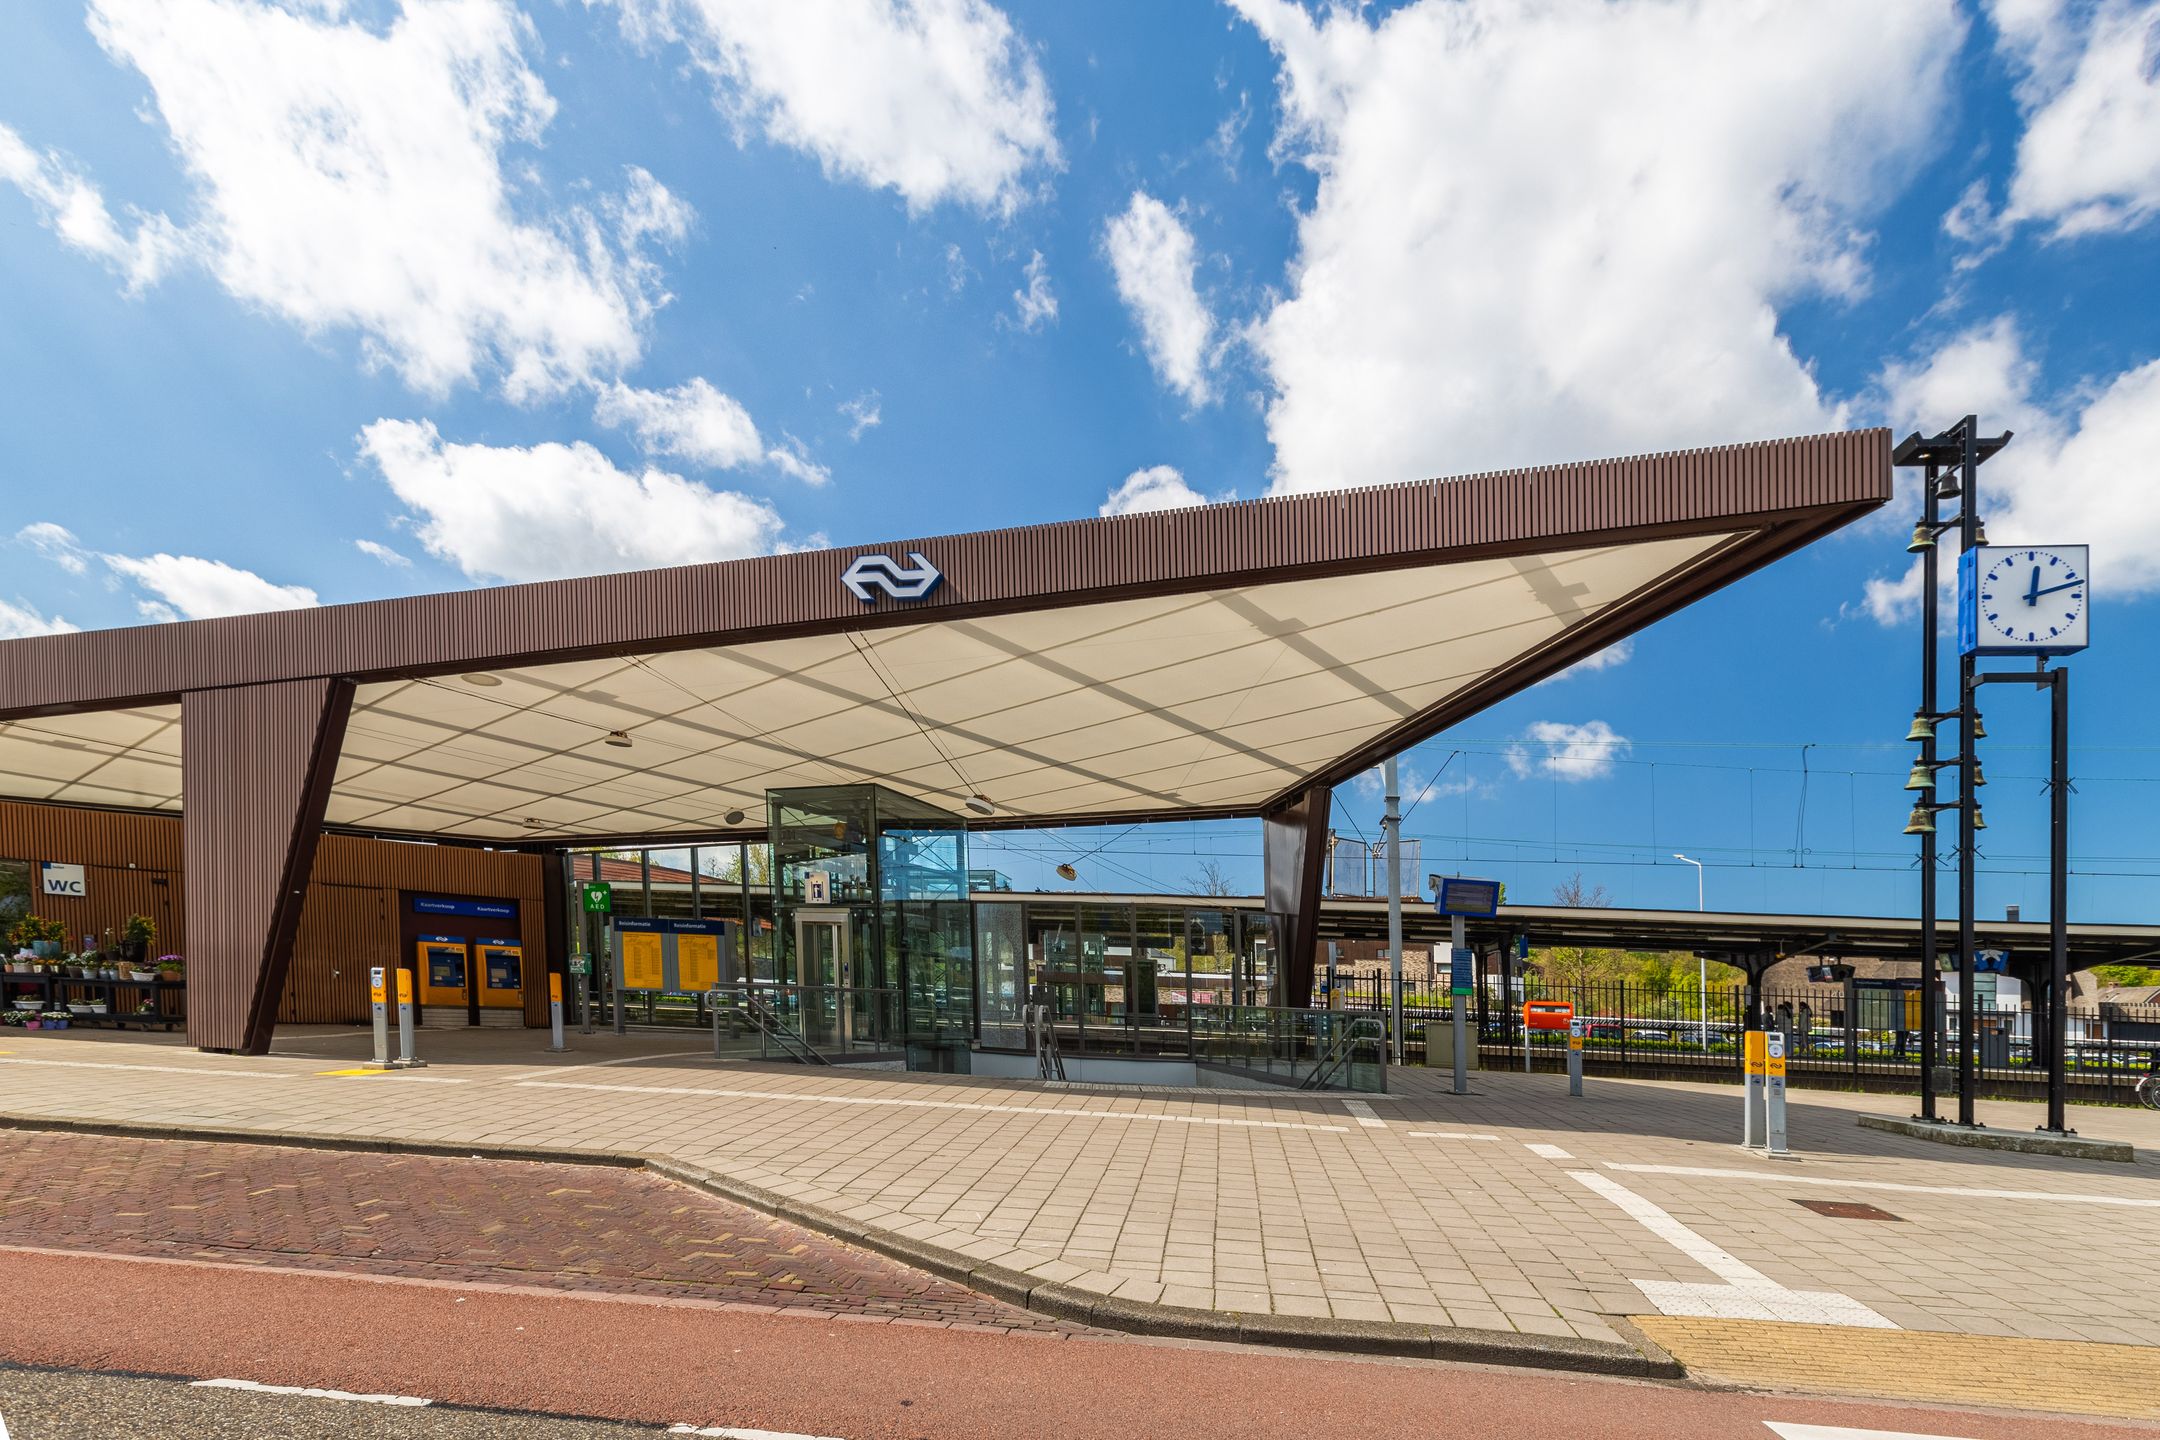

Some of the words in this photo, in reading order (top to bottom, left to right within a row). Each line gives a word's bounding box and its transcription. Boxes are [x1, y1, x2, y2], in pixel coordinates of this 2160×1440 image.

[48, 879, 81, 893] WC
[420, 902, 455, 910] Kaartverkoop
[477, 906, 510, 914] Kaartverkoop
